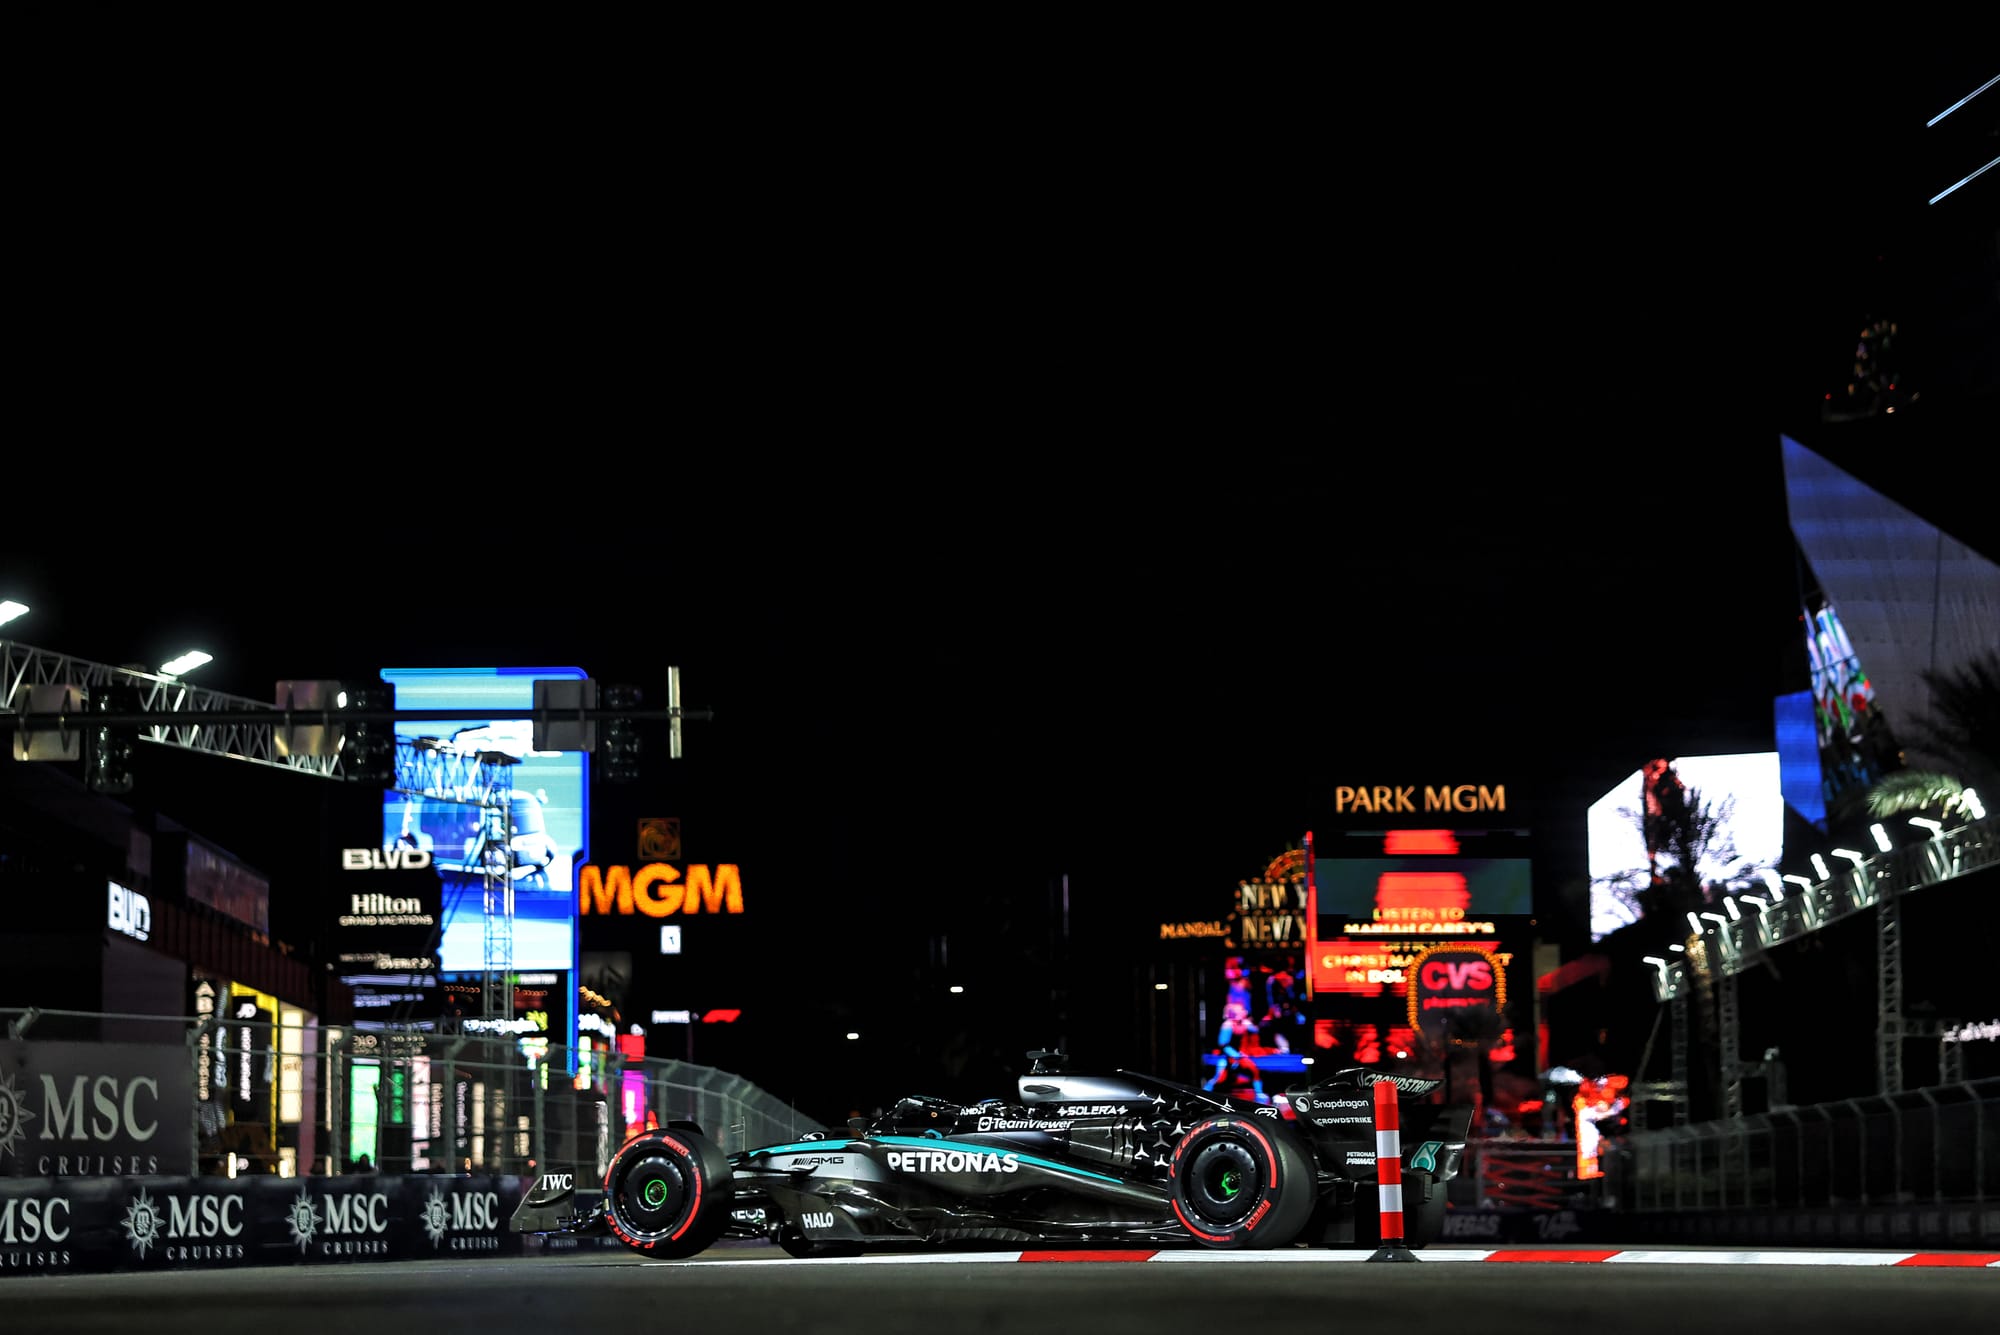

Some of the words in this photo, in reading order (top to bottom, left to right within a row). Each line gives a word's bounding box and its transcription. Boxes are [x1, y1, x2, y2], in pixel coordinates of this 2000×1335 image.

[1335, 785, 1416, 813] PARK
[1424, 784, 1506, 813] MGM
[342, 849, 431, 870] BLVD
[579, 863, 742, 917] MGM
[1241, 884, 1286, 910] NEW
[351, 893, 420, 915] Hilton
[339, 914, 377, 926] GRAND
[378, 914, 433, 926] VACATIONS
[1372, 907, 1434, 921] LISTEN
[1440, 907, 1464, 921] TO
[1160, 921, 1227, 939] MANDAL
[1241, 915, 1291, 941] NEW
[1322, 954, 1414, 968] CHRISTMA
[1420, 961, 1493, 991] CVS
[40, 1074, 159, 1142] MSC
[1067, 1105, 1116, 1116] SOLERA
[1313, 1100, 1369, 1110] Snapdragon
[993, 1119, 1074, 1129] TeamViewer
[1317, 1117, 1372, 1125] CROWDSTRIKE
[38, 1155, 158, 1175] CRUISES
[808, 1157, 844, 1165] AMG
[886, 1152, 1020, 1174] PETRONAS
[541, 1174, 573, 1191] IWC
[167, 1194, 243, 1238] MSC
[323, 1193, 388, 1234] MSC
[451, 1192, 499, 1231] MSC
[801, 1212, 834, 1229] HALO
[166, 1245, 244, 1260] CRUISES
[323, 1240, 389, 1256] CRUISES
[0, 1250, 70, 1267] UISES
